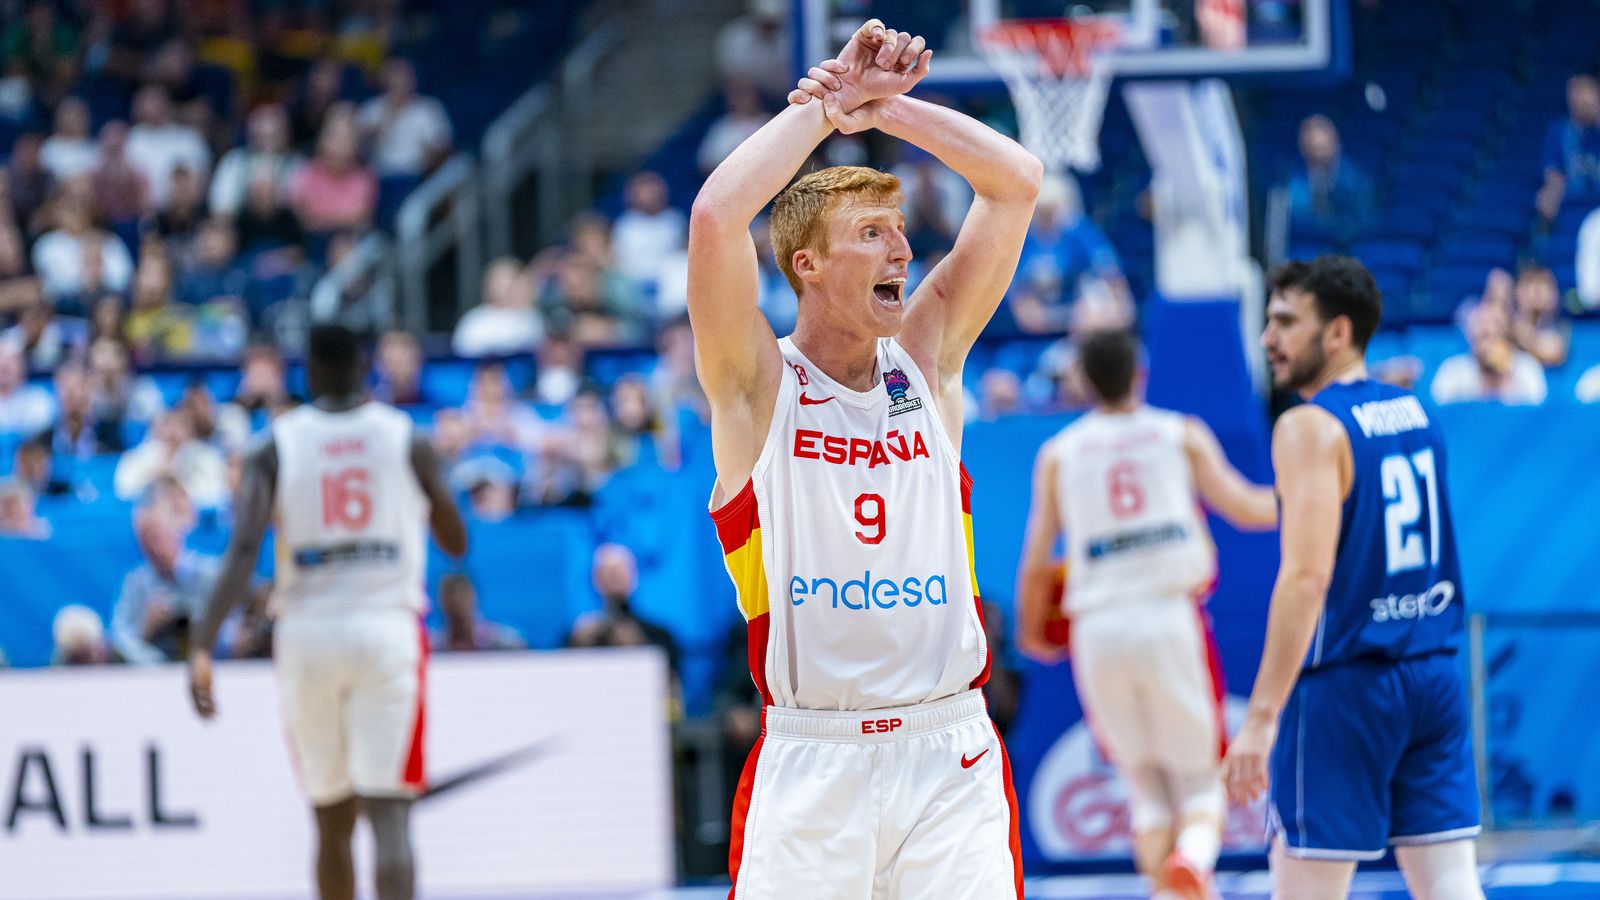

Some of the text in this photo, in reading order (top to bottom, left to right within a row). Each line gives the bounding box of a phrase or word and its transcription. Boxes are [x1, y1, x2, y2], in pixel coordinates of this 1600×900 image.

[793, 429, 930, 469] ESPAÑA
[320, 466, 373, 532] 16
[1106, 459, 1146, 520] 6
[1380, 447, 1440, 576] 21
[854, 493, 887, 545] 9
[789, 570, 948, 610] endesa
[861, 717, 903, 735] ESP
[4, 742, 199, 832] ALL
